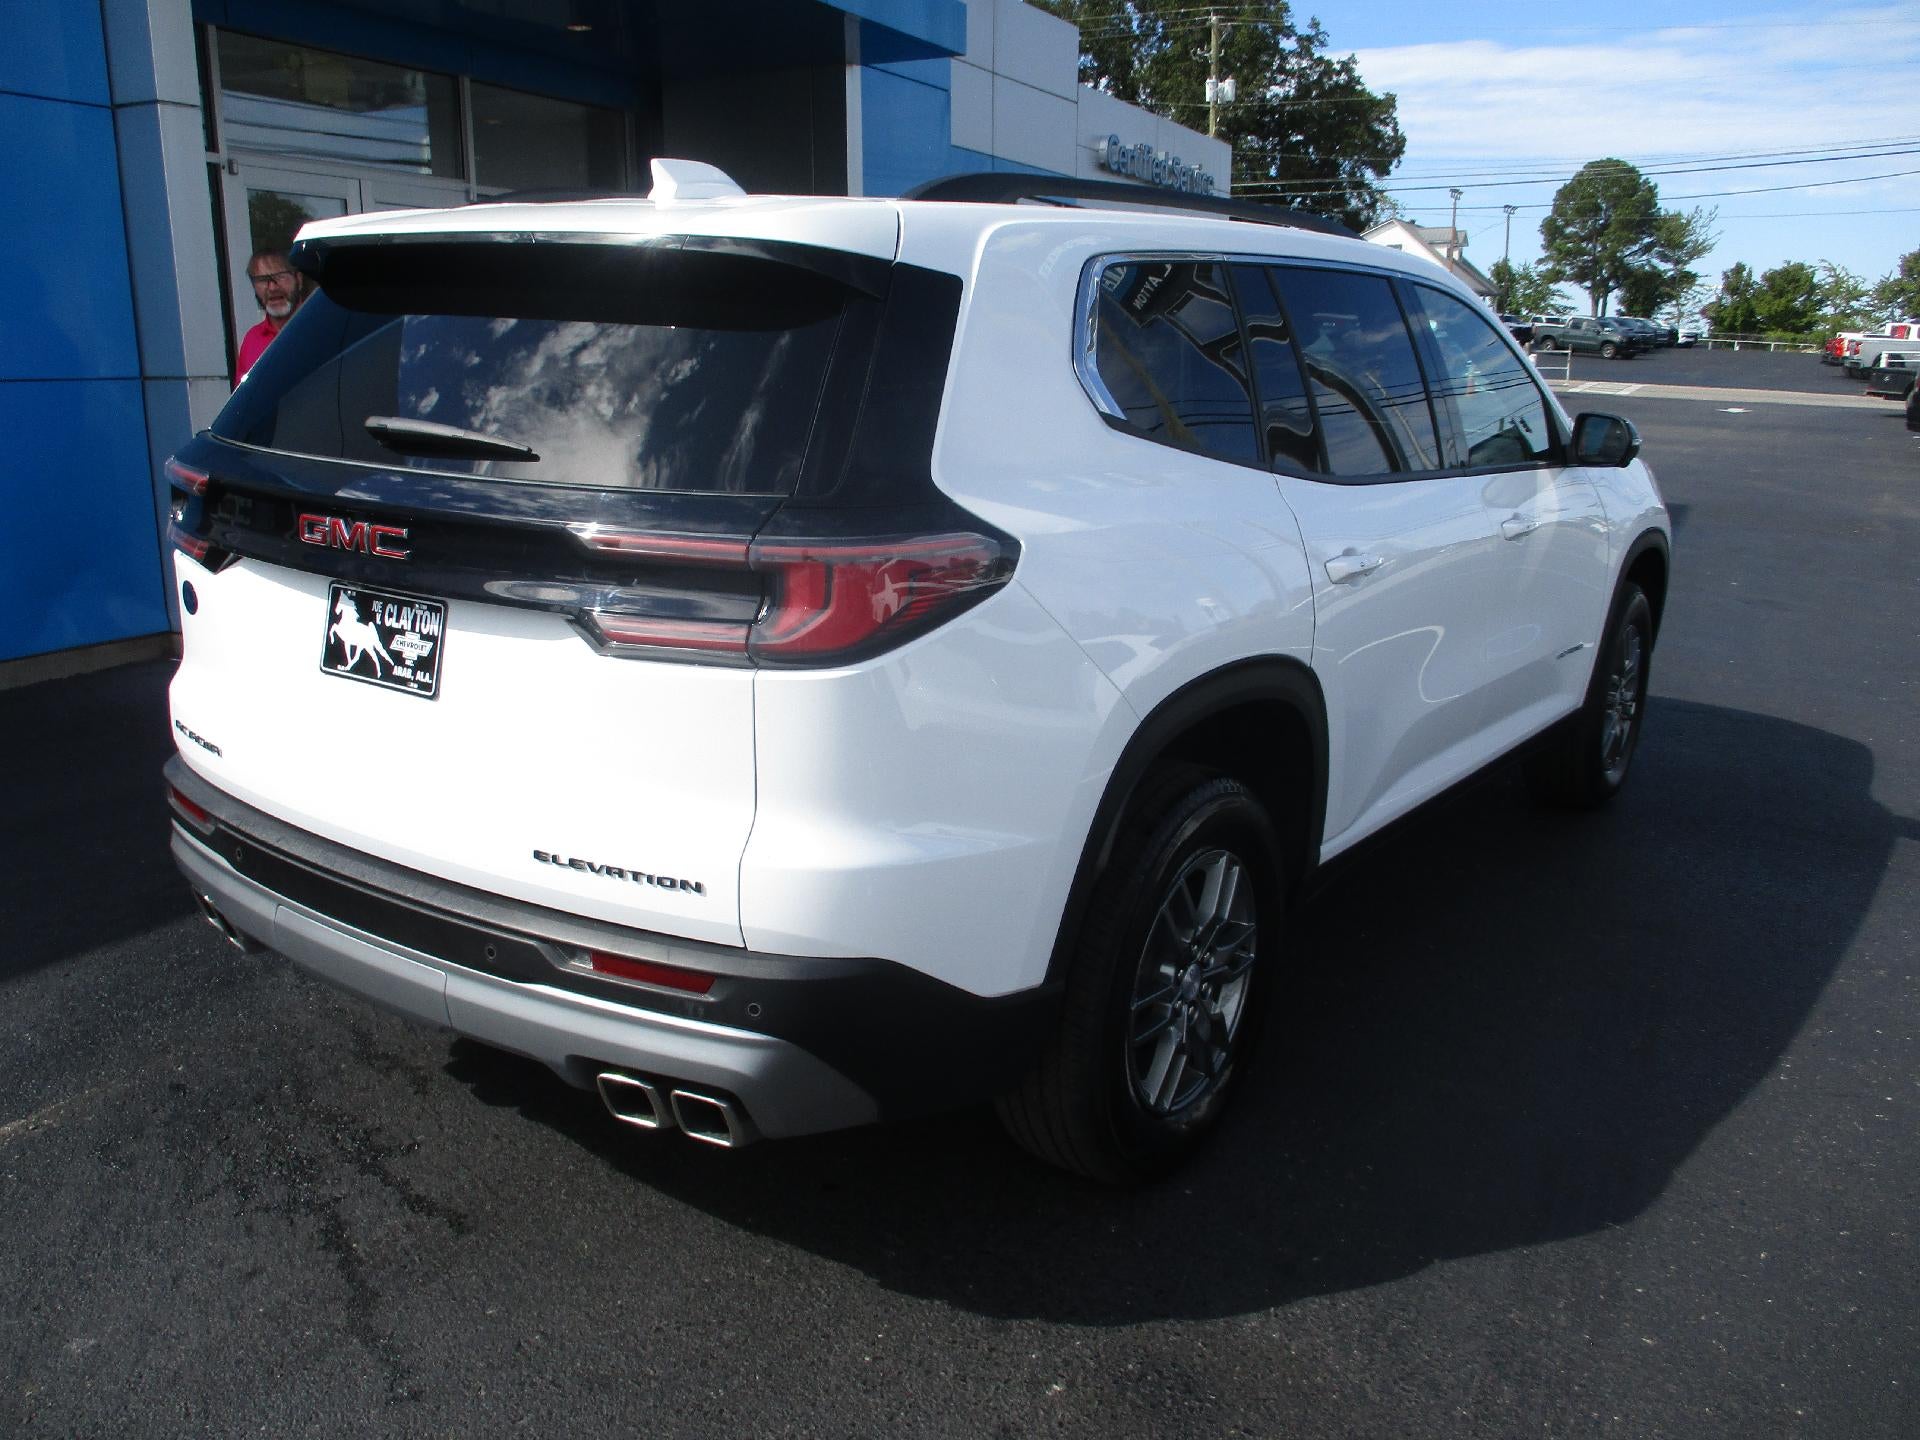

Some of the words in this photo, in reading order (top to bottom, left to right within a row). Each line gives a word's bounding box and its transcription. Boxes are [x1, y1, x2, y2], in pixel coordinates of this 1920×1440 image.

[1107, 134, 1169, 185] Certified
[298, 513, 410, 560] GMC
[372, 600, 383, 612] JOE
[385, 604, 440, 636] CLAYTON
[395, 638, 428, 652] CHEVROLET
[415, 671, 432, 683] ALA.
[533, 849, 707, 897] ELEVATION
